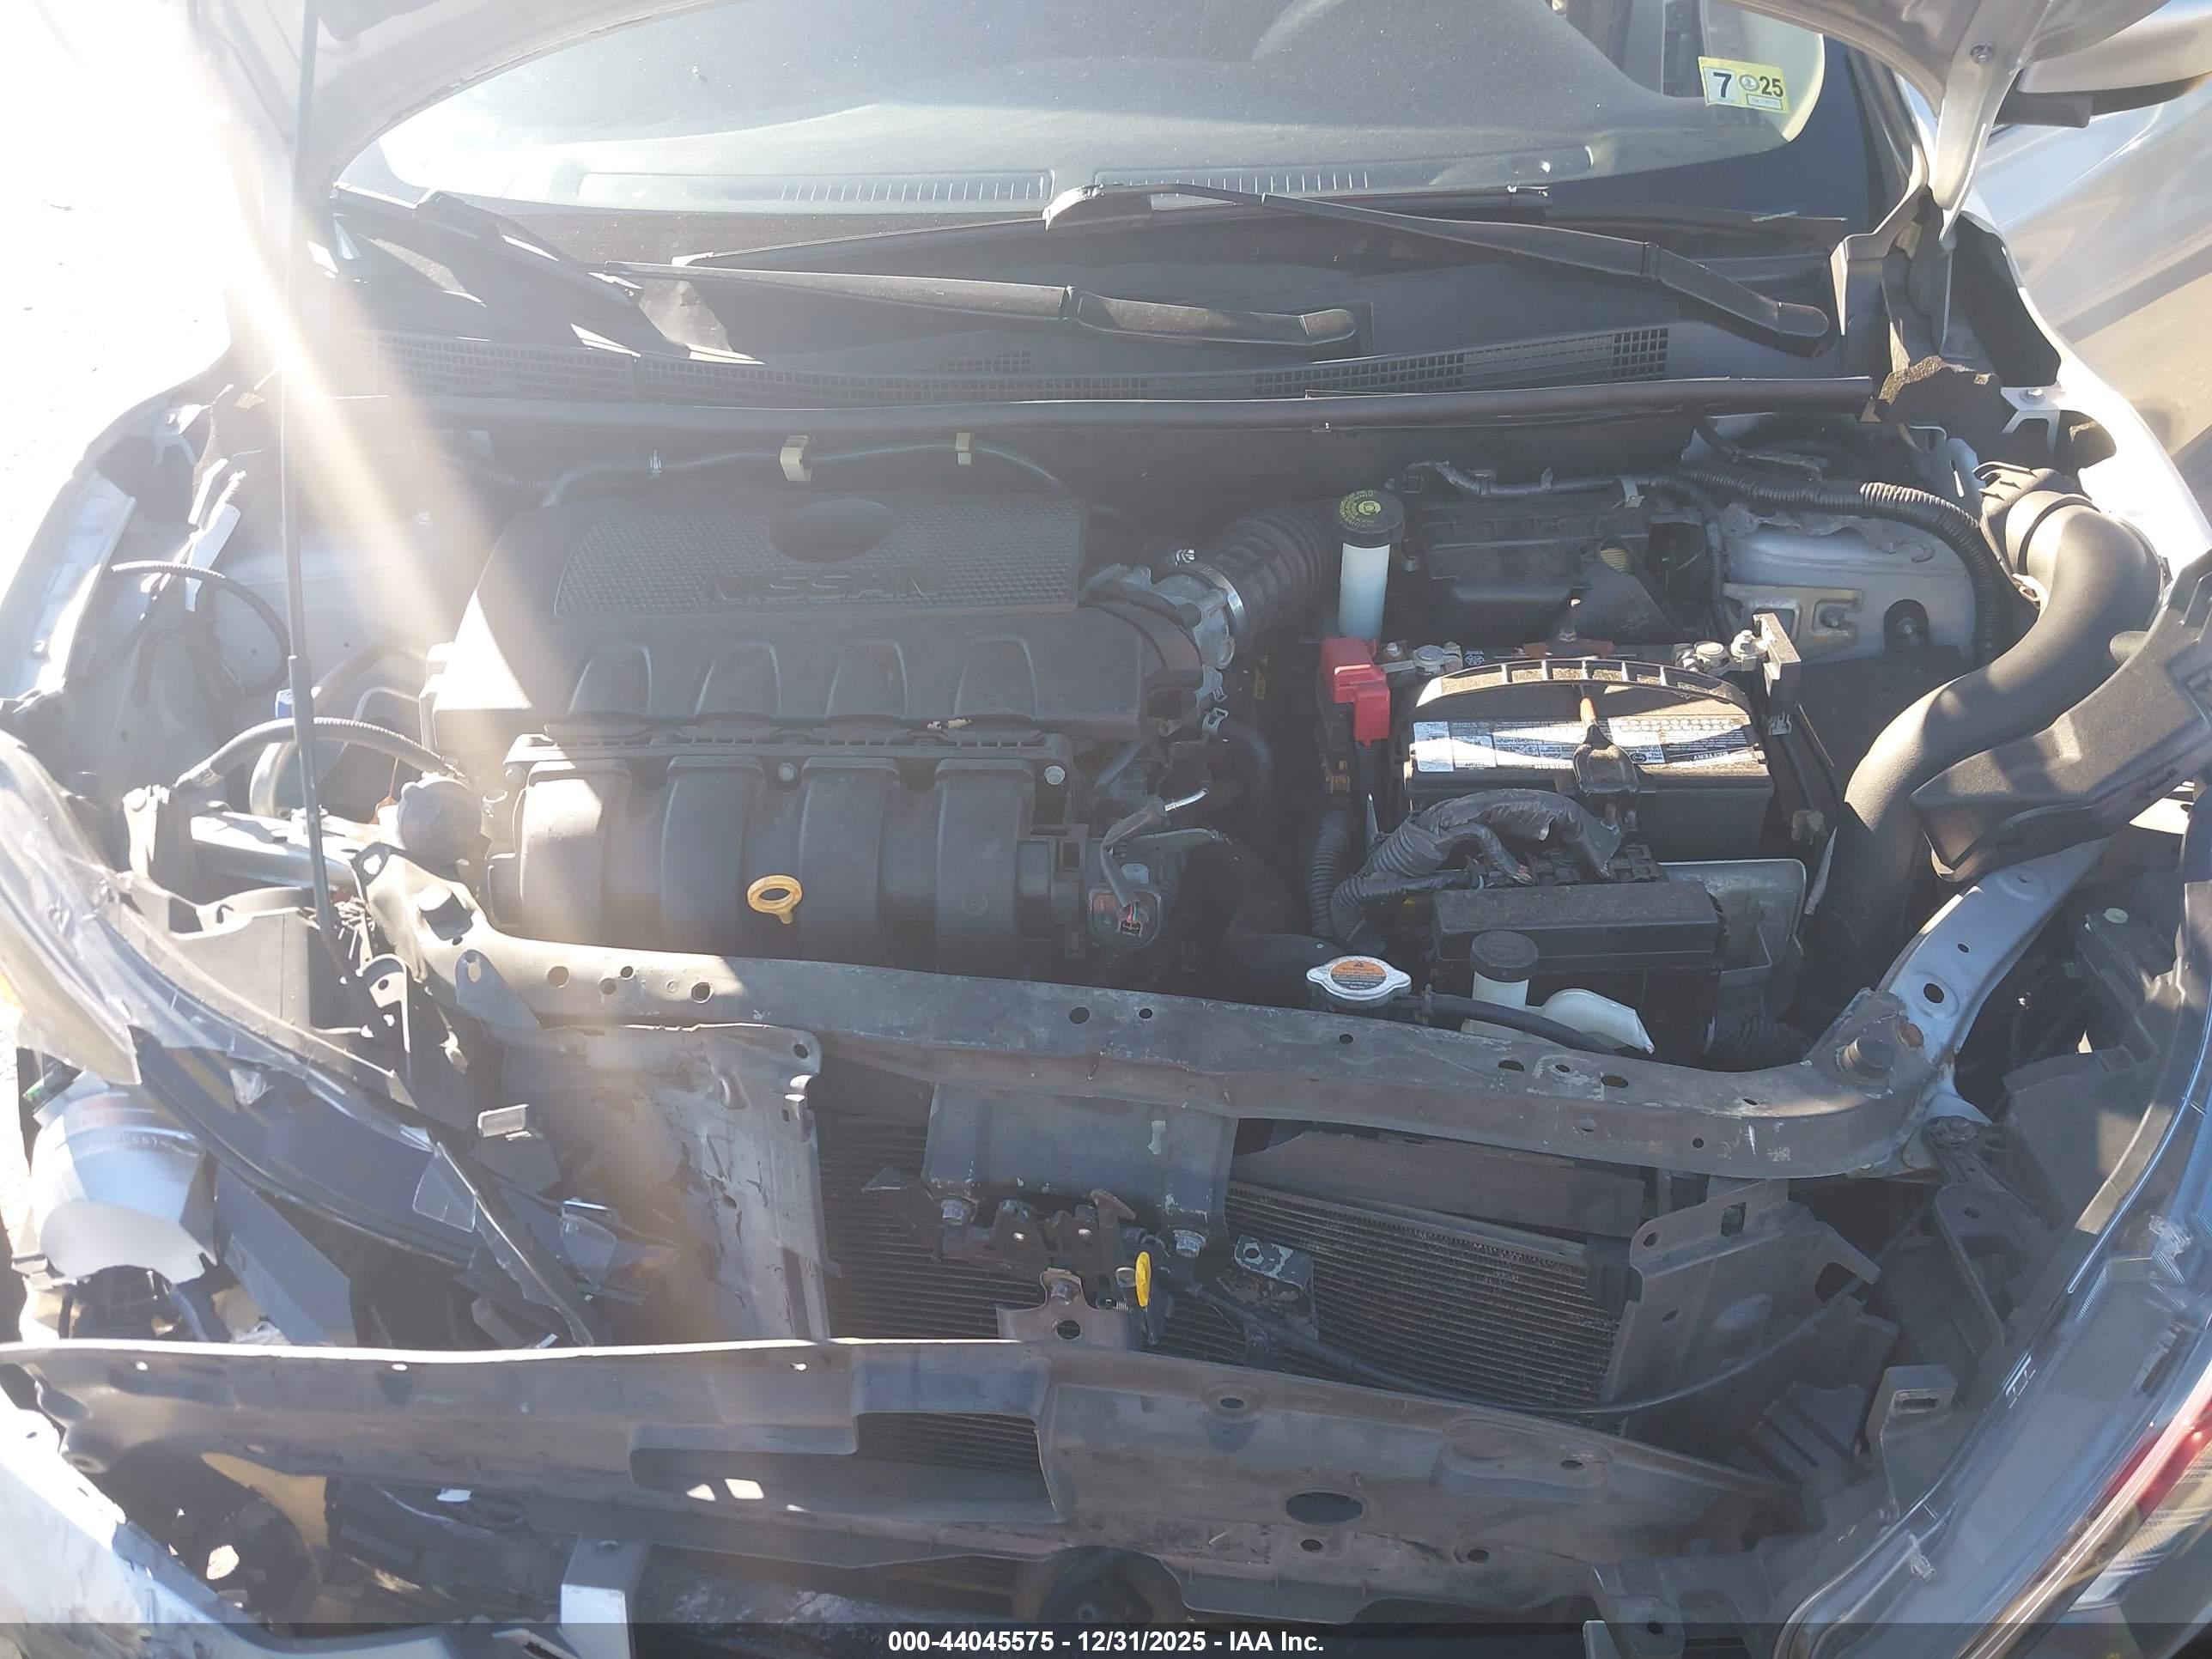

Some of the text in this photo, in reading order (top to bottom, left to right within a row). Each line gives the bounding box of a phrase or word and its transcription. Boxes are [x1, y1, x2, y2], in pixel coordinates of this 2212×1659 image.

[1713, 71, 1784, 98] 7 25
[704, 573, 943, 600] NISSAN
